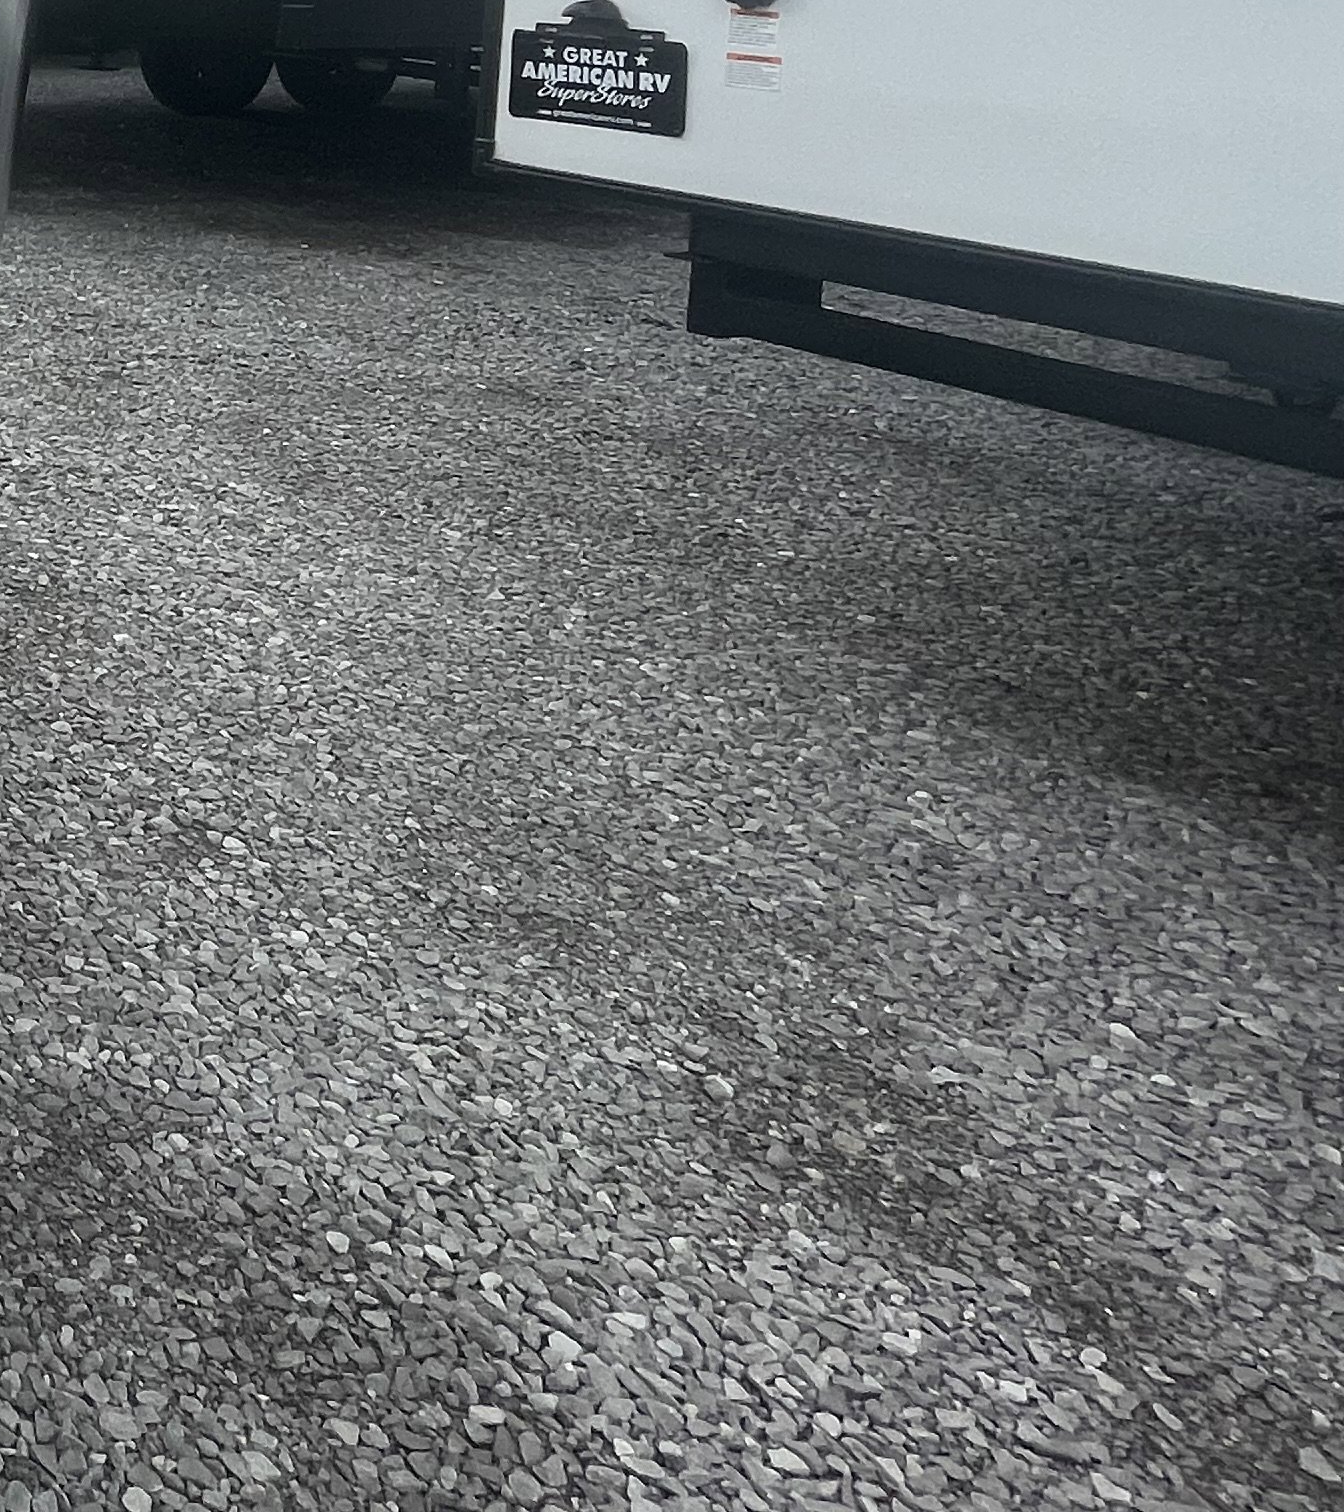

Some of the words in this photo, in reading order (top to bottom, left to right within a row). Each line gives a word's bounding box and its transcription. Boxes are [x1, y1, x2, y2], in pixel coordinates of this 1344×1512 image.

[562, 46, 629, 68] GREAT
[520, 61, 634, 90] AMERICAN
[639, 71, 672, 94] RV
[536, 79, 653, 110] SuperStores
